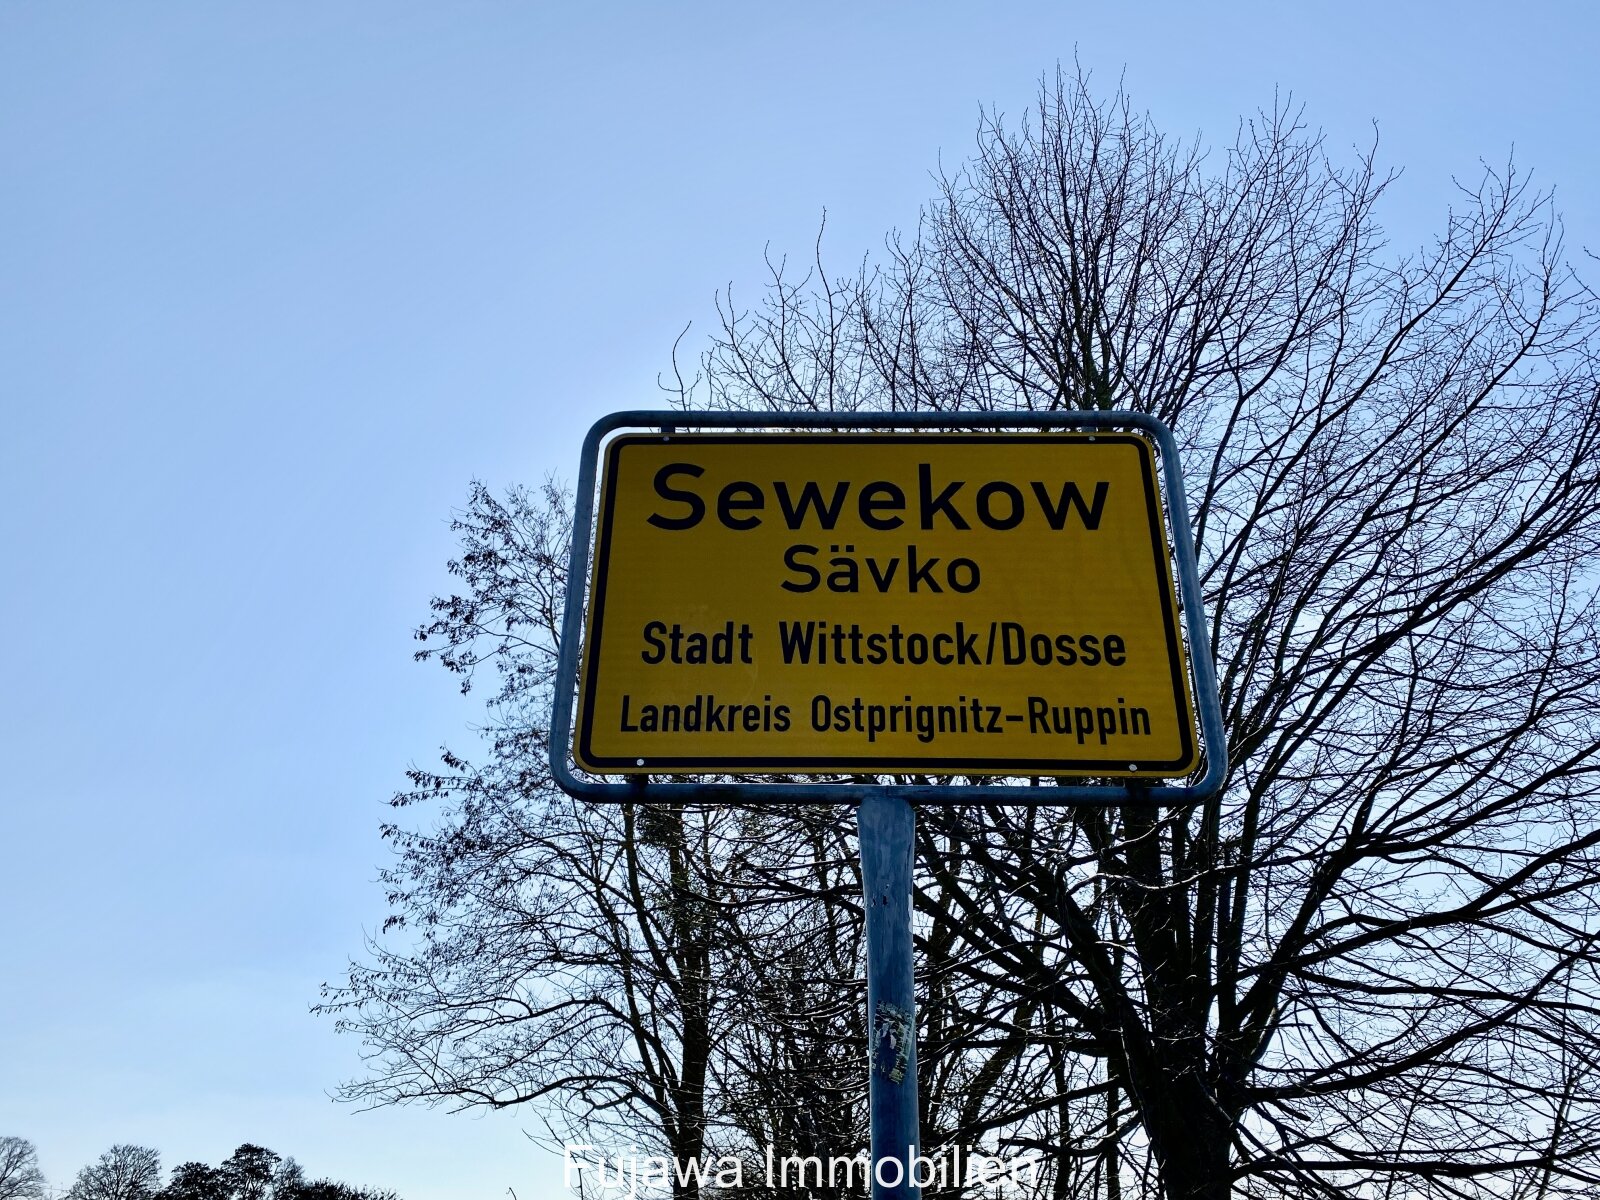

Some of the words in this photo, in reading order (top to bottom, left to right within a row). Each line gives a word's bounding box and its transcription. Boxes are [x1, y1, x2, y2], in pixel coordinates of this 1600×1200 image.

[646, 462, 1109, 531] Sewekow
[780, 544, 981, 594] Sävko
[641, 621, 753, 665] Stadt
[779, 621, 1127, 667] Wittstock/Dosse
[620, 695, 791, 733] Landkreis
[812, 695, 1151, 745] Ostprignitz-Ruppin
